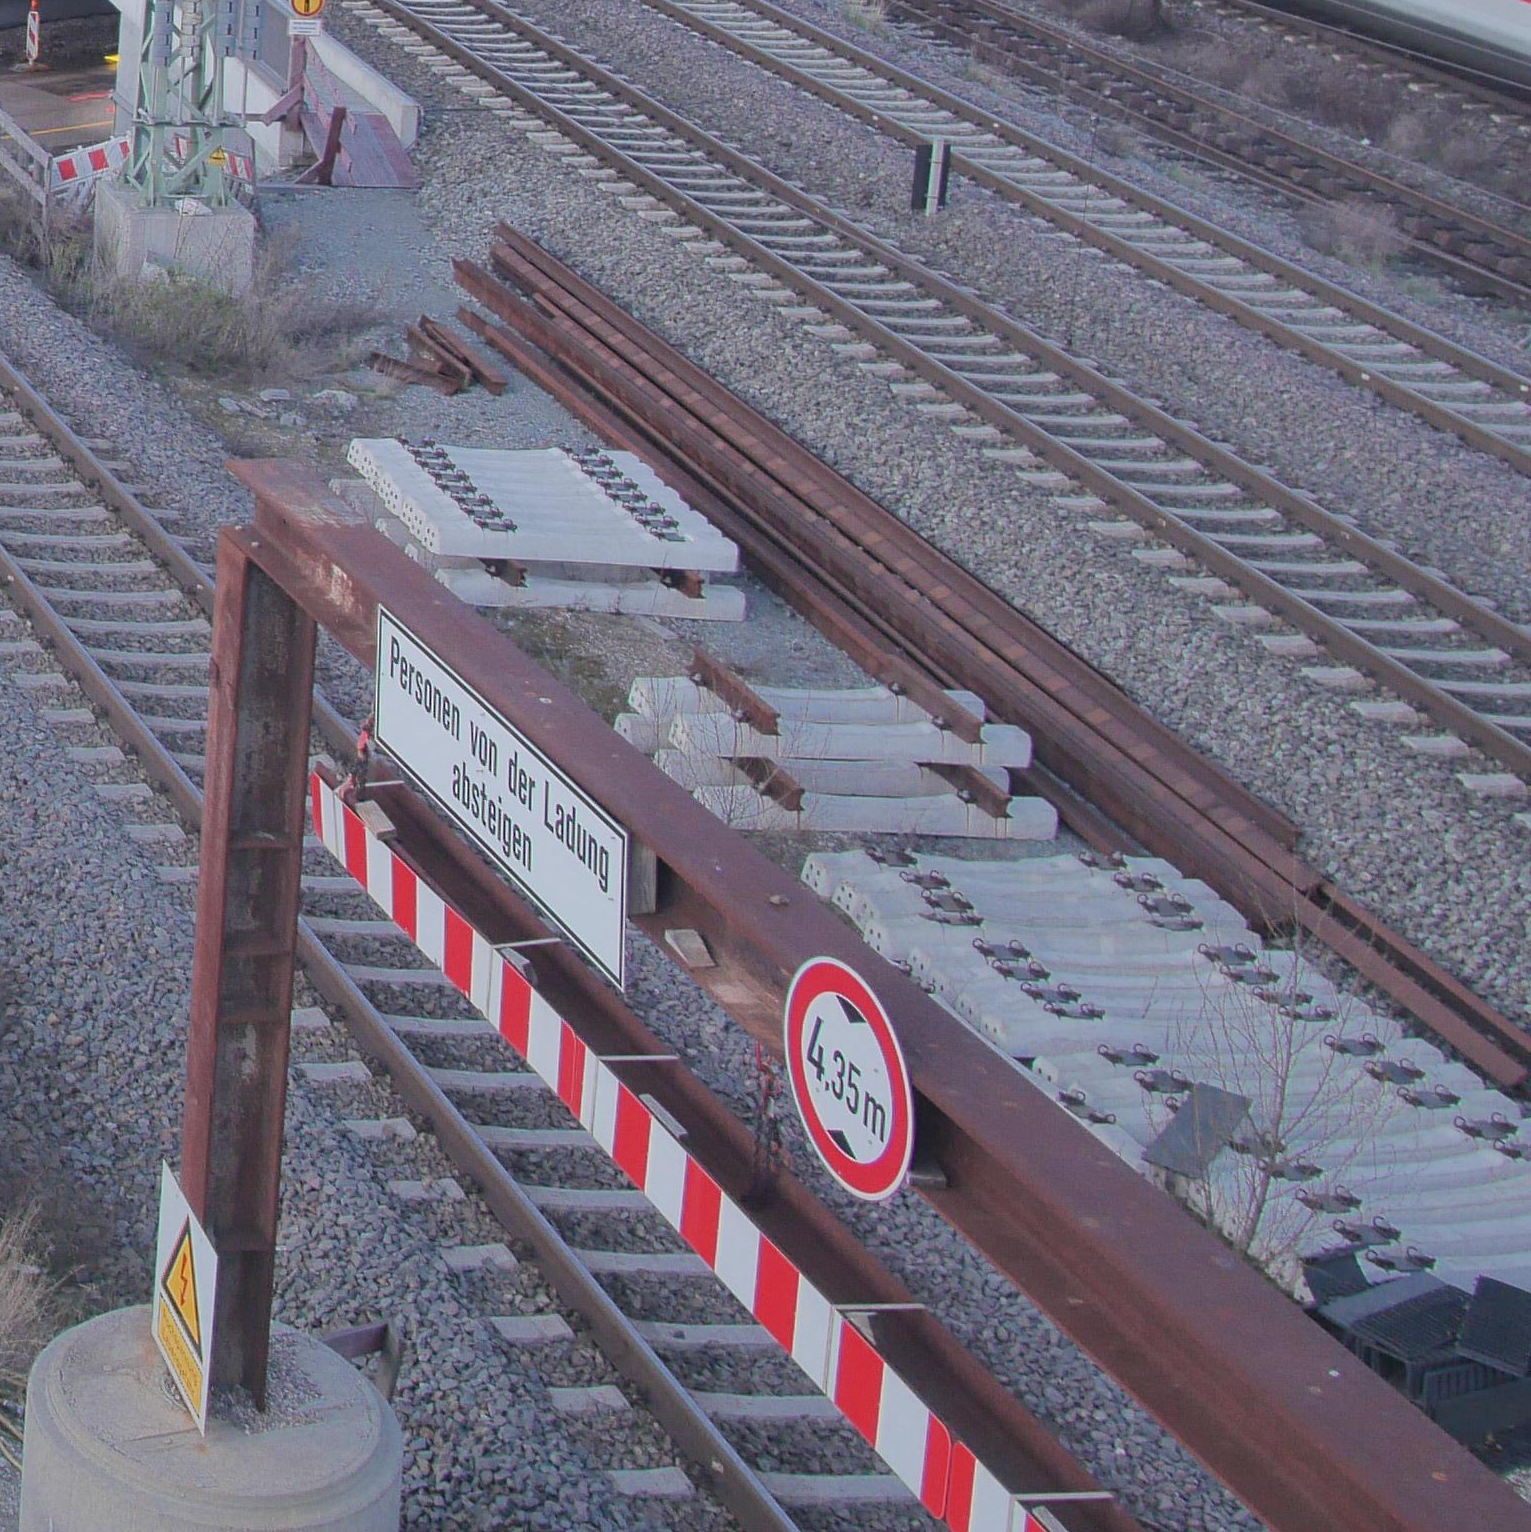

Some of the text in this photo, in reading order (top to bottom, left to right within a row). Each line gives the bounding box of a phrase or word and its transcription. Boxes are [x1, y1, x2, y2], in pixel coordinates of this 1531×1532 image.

[389, 635, 611, 894] Personen von der Ladung
[452, 762, 533, 872] absteigen
